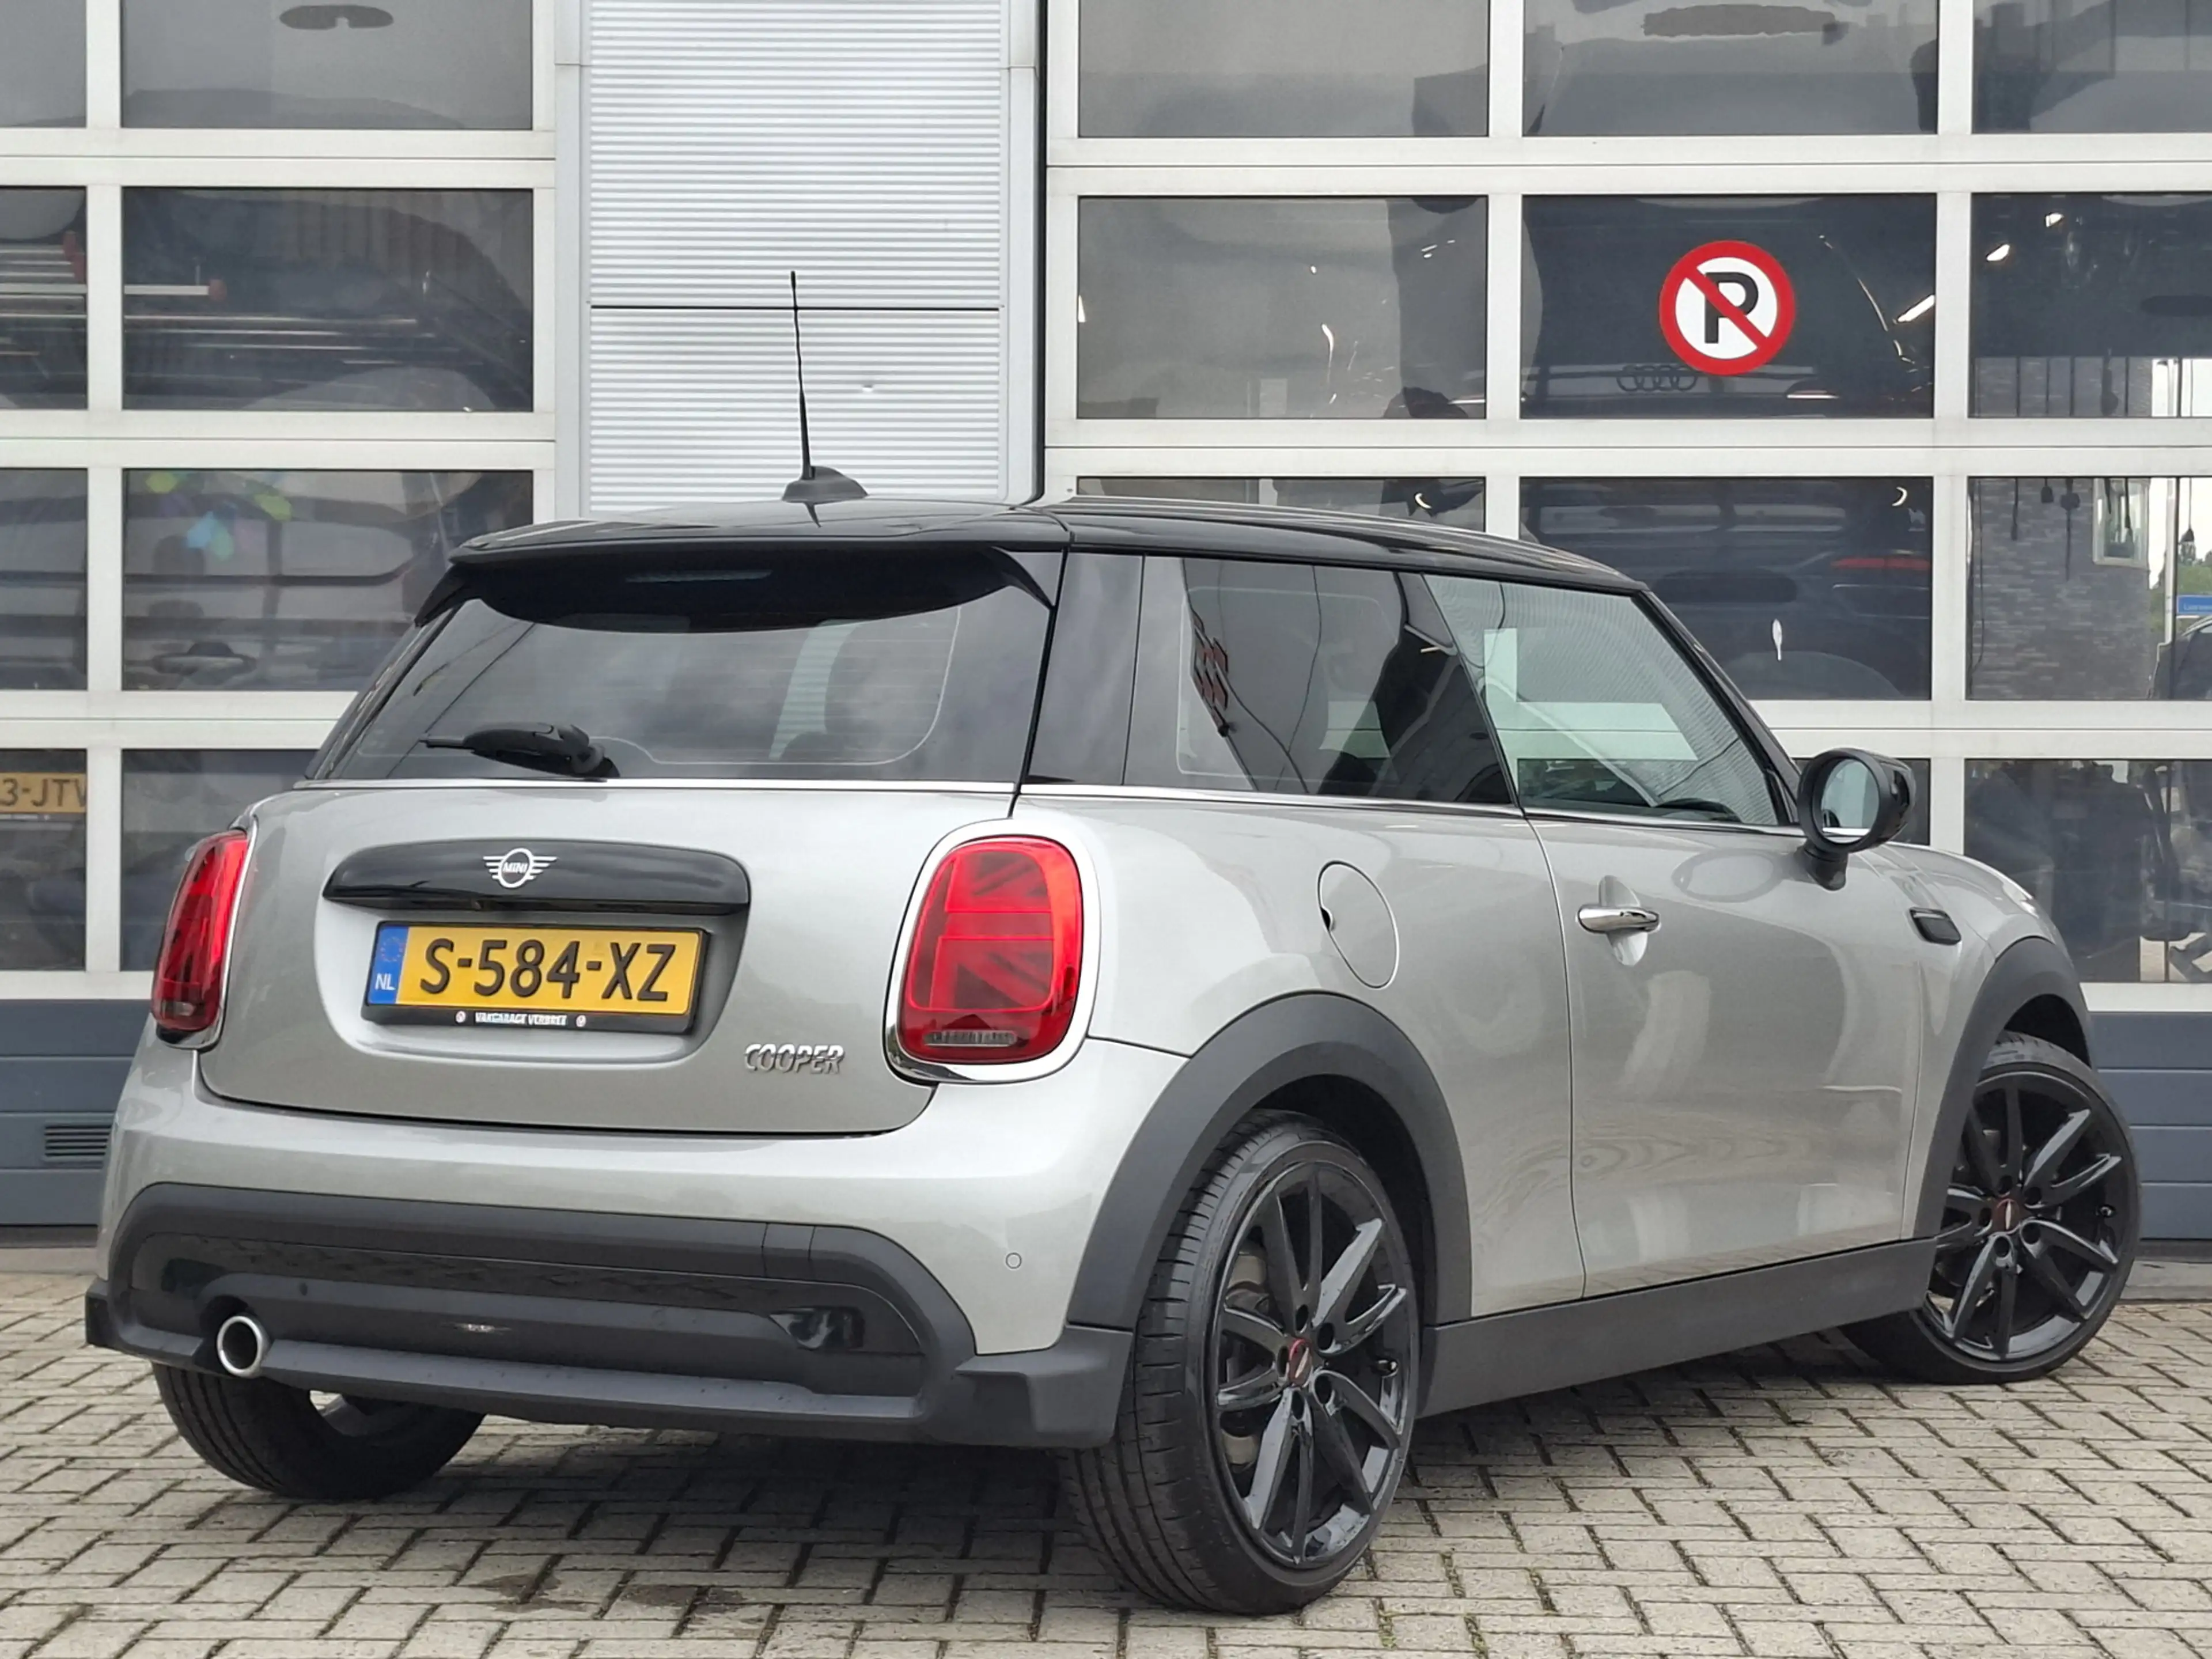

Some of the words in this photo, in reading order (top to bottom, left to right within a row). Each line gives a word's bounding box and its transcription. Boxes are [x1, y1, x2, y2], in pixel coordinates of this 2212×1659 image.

[1705, 272, 1759, 343] P
[502, 862, 528, 873] MINI
[375, 974, 396, 991] NL
[420, 938, 676, 1001] S-584-XZ
[745, 1044, 844, 1074] COOPER
